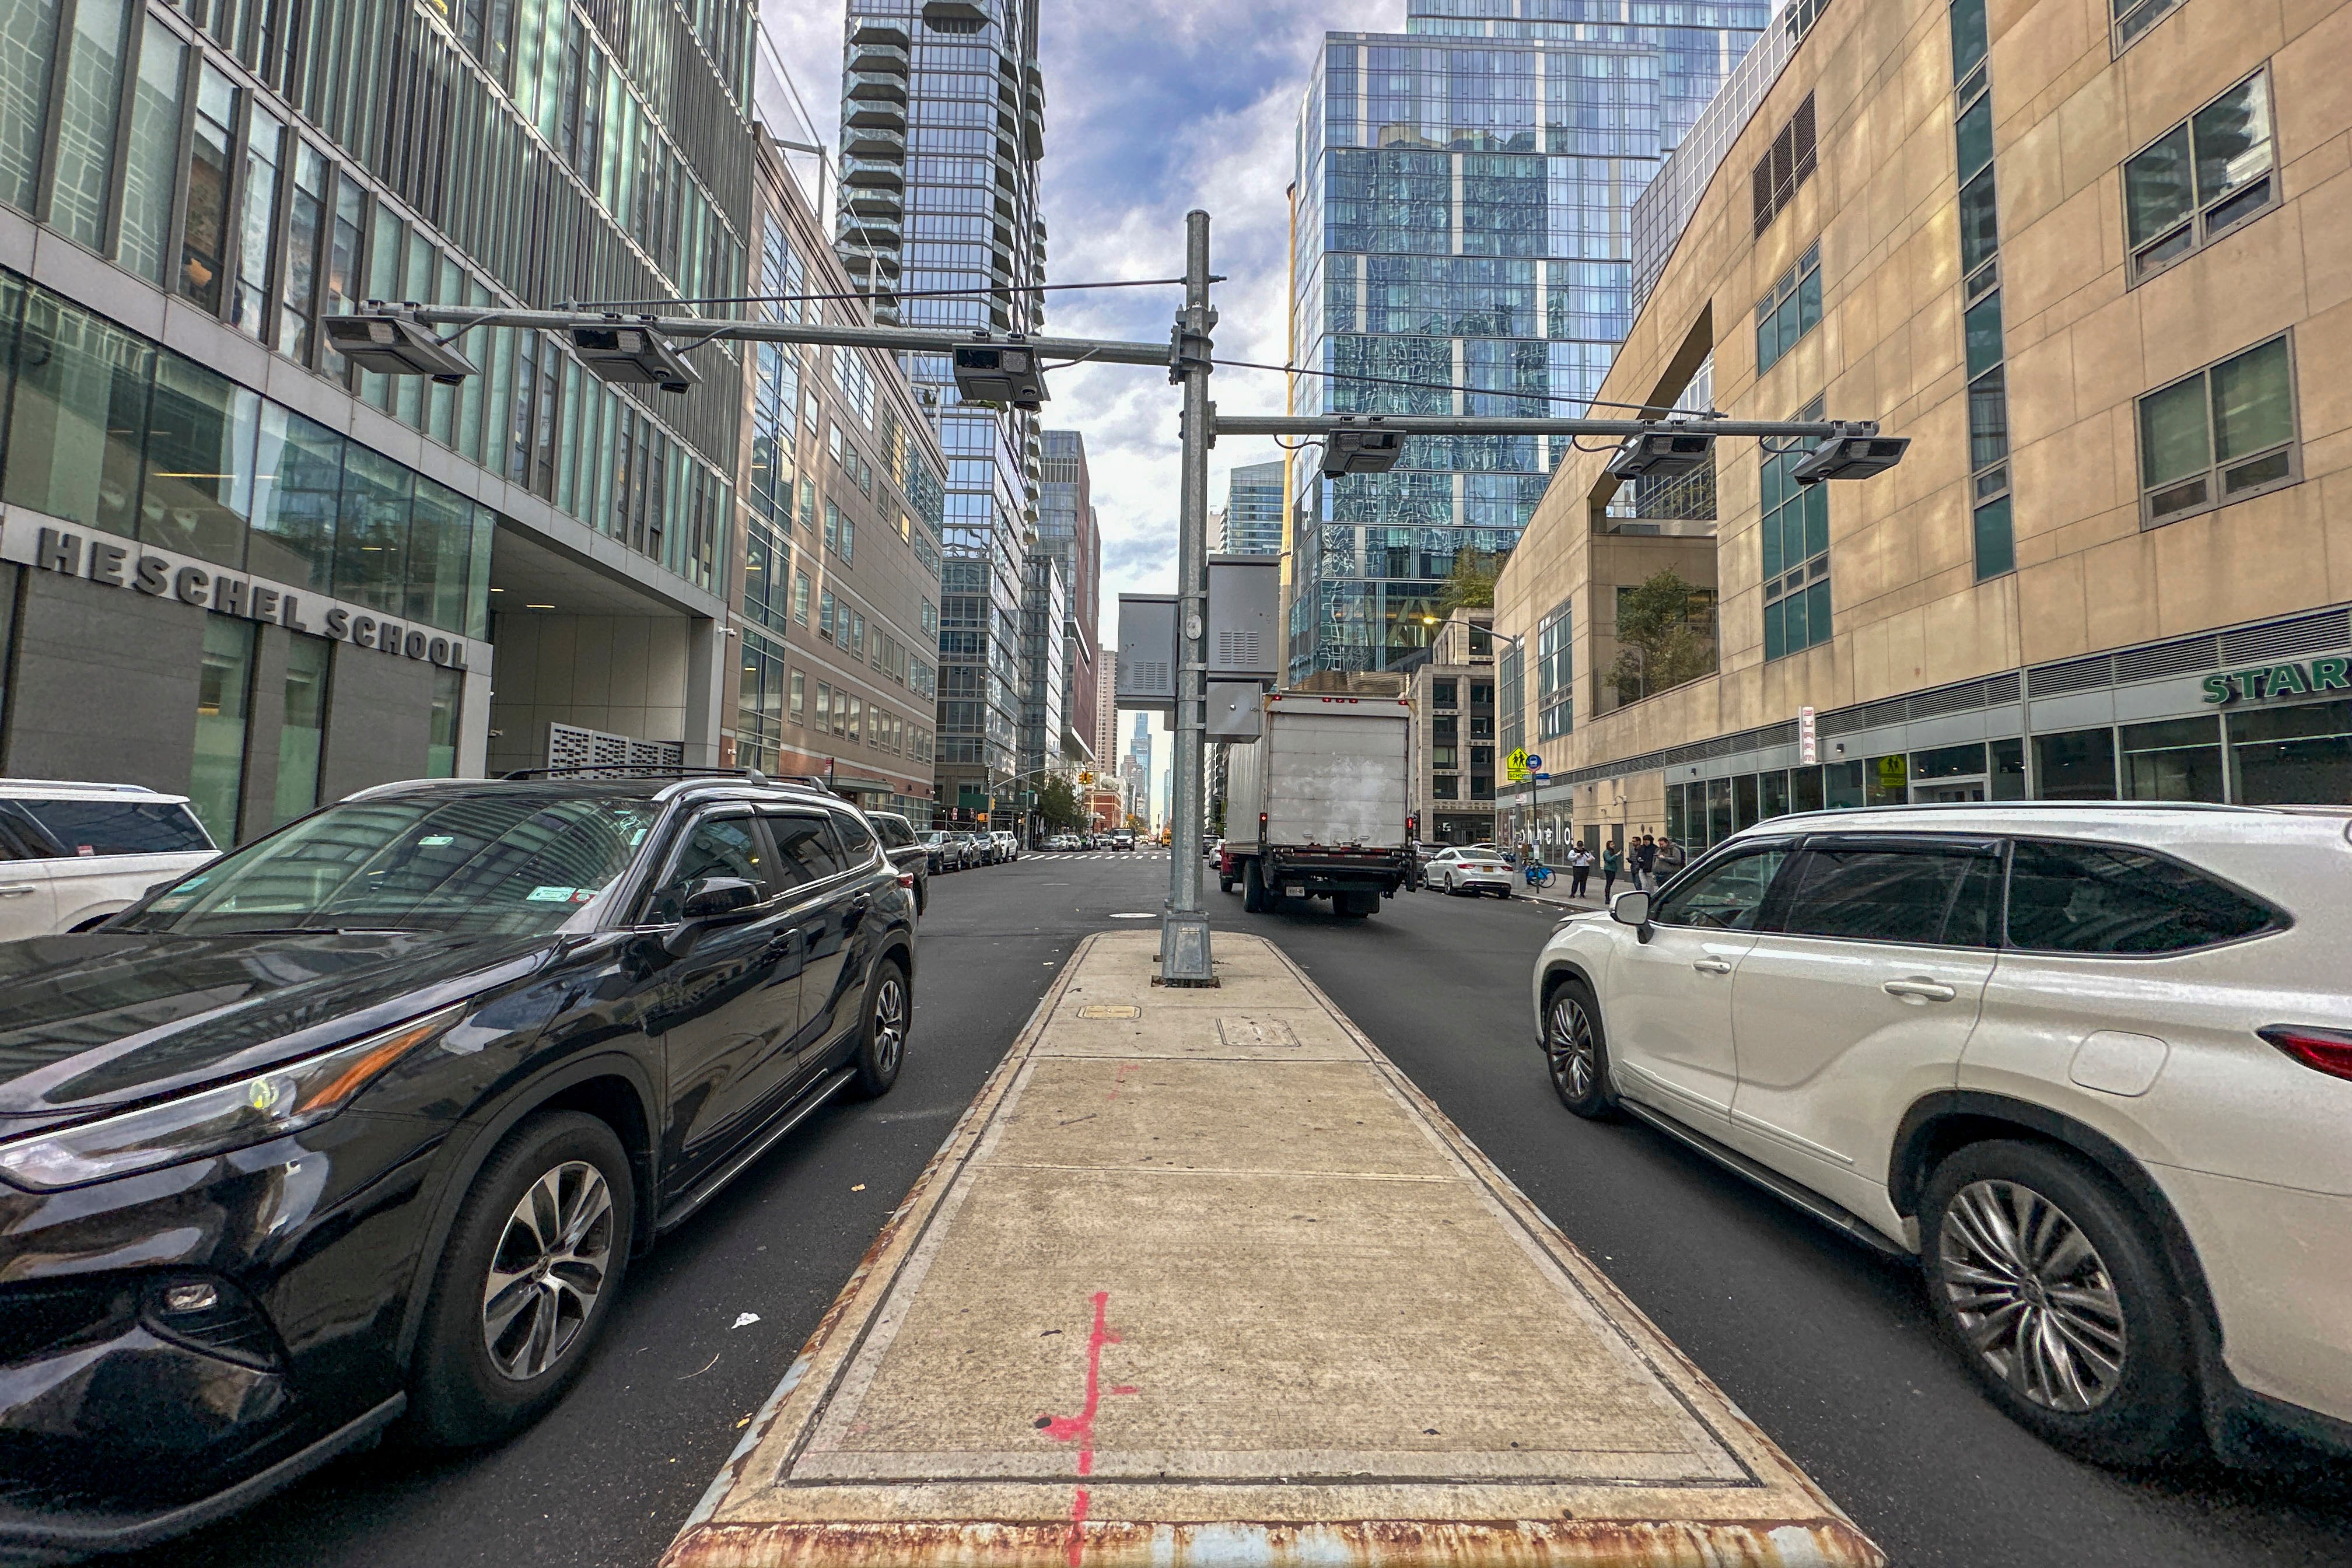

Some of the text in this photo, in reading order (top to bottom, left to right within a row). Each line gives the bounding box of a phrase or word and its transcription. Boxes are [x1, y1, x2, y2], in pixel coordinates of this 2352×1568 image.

[37, 527, 468, 671] HESCHEL SCHOOL
[2202, 657, 2351, 705] STAR
